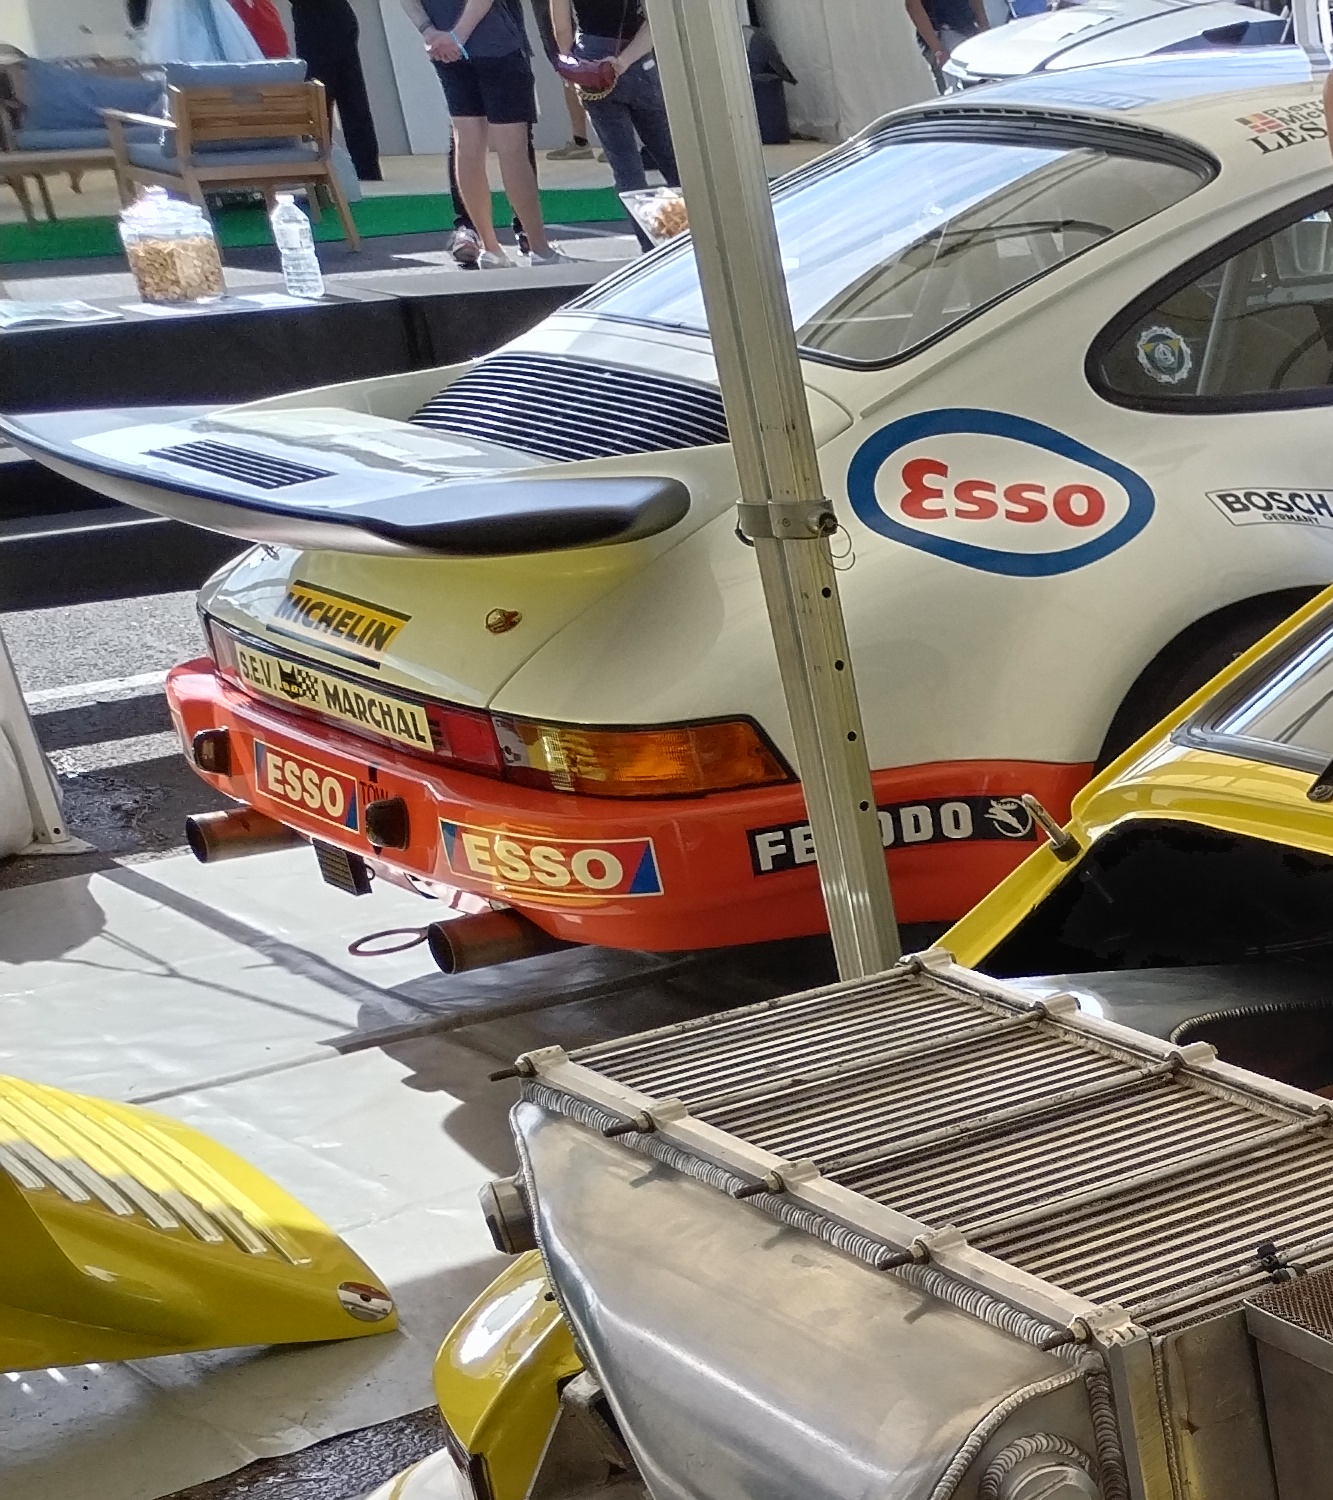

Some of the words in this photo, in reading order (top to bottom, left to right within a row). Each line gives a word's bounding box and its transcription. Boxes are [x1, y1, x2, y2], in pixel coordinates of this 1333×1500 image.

[1262, 512, 1321, 526] GERMANY
[274, 591, 398, 652] MICHELIN
[321, 678, 427, 744] MARCHAL
[265, 751, 345, 818] ESSO
[461, 832, 624, 890] ESSO
[754, 801, 974, 872] FEDO
